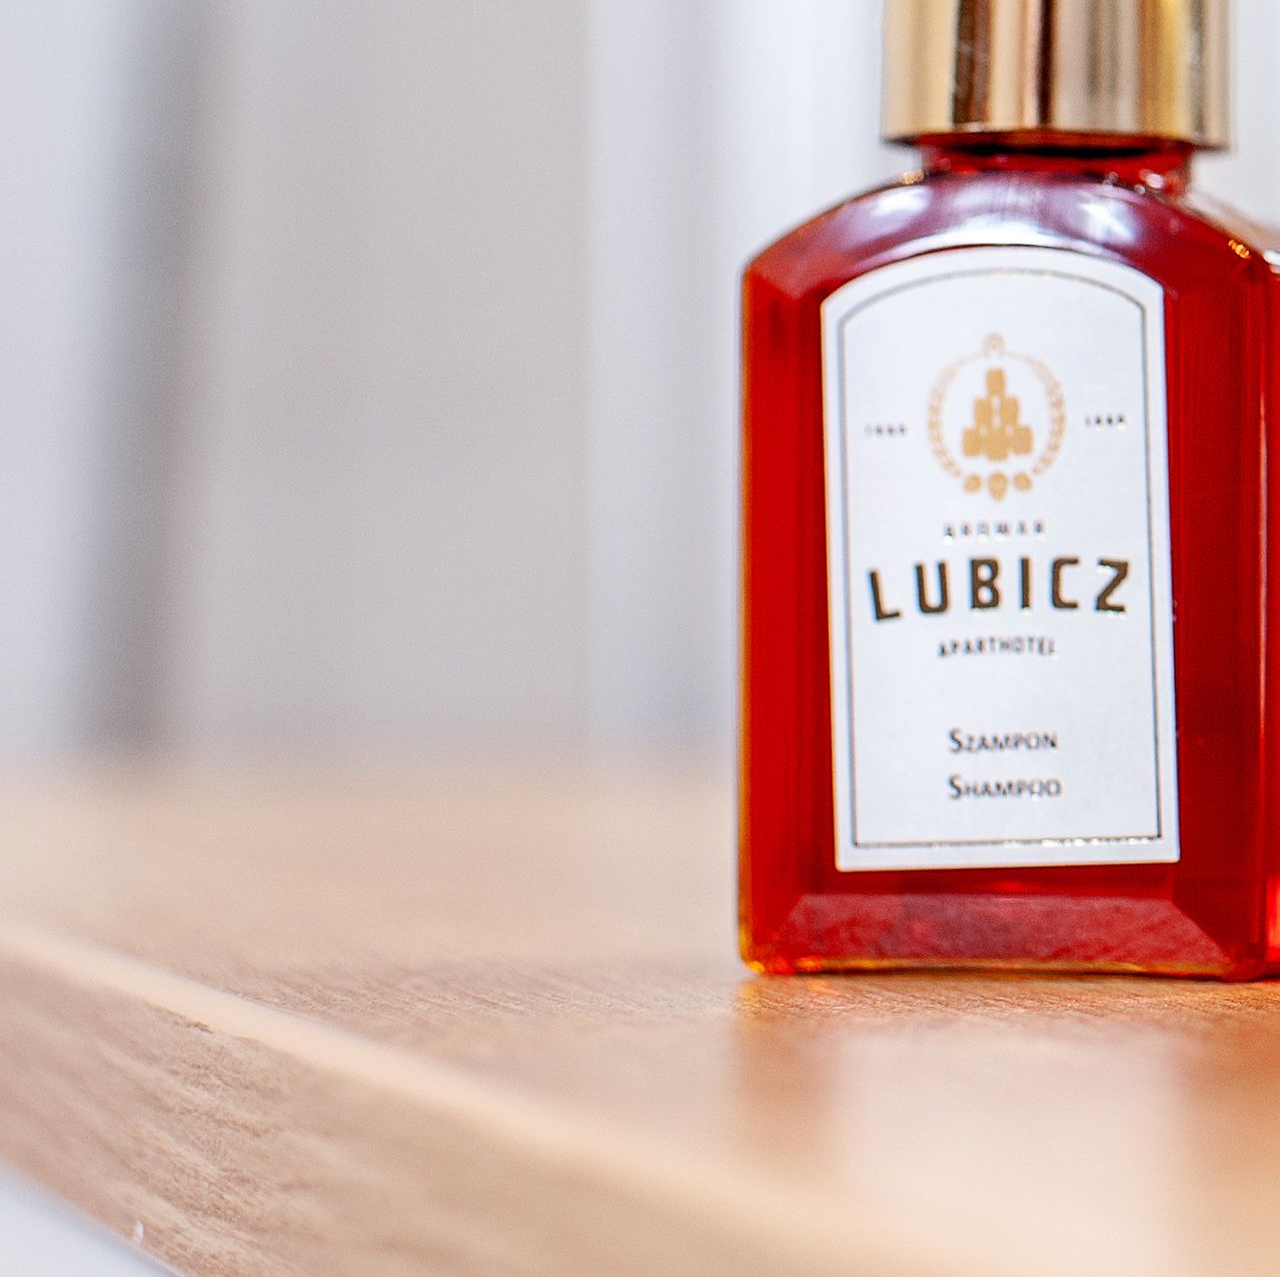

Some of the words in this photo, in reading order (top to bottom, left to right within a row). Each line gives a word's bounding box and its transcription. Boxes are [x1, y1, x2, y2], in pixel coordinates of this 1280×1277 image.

[868, 556, 1129, 622] LUBICZ
[938, 637, 1057, 658] APARTHOTEL
[948, 728, 1058, 754] SZAMPON
[948, 774, 1062, 800] SHAMPOO
